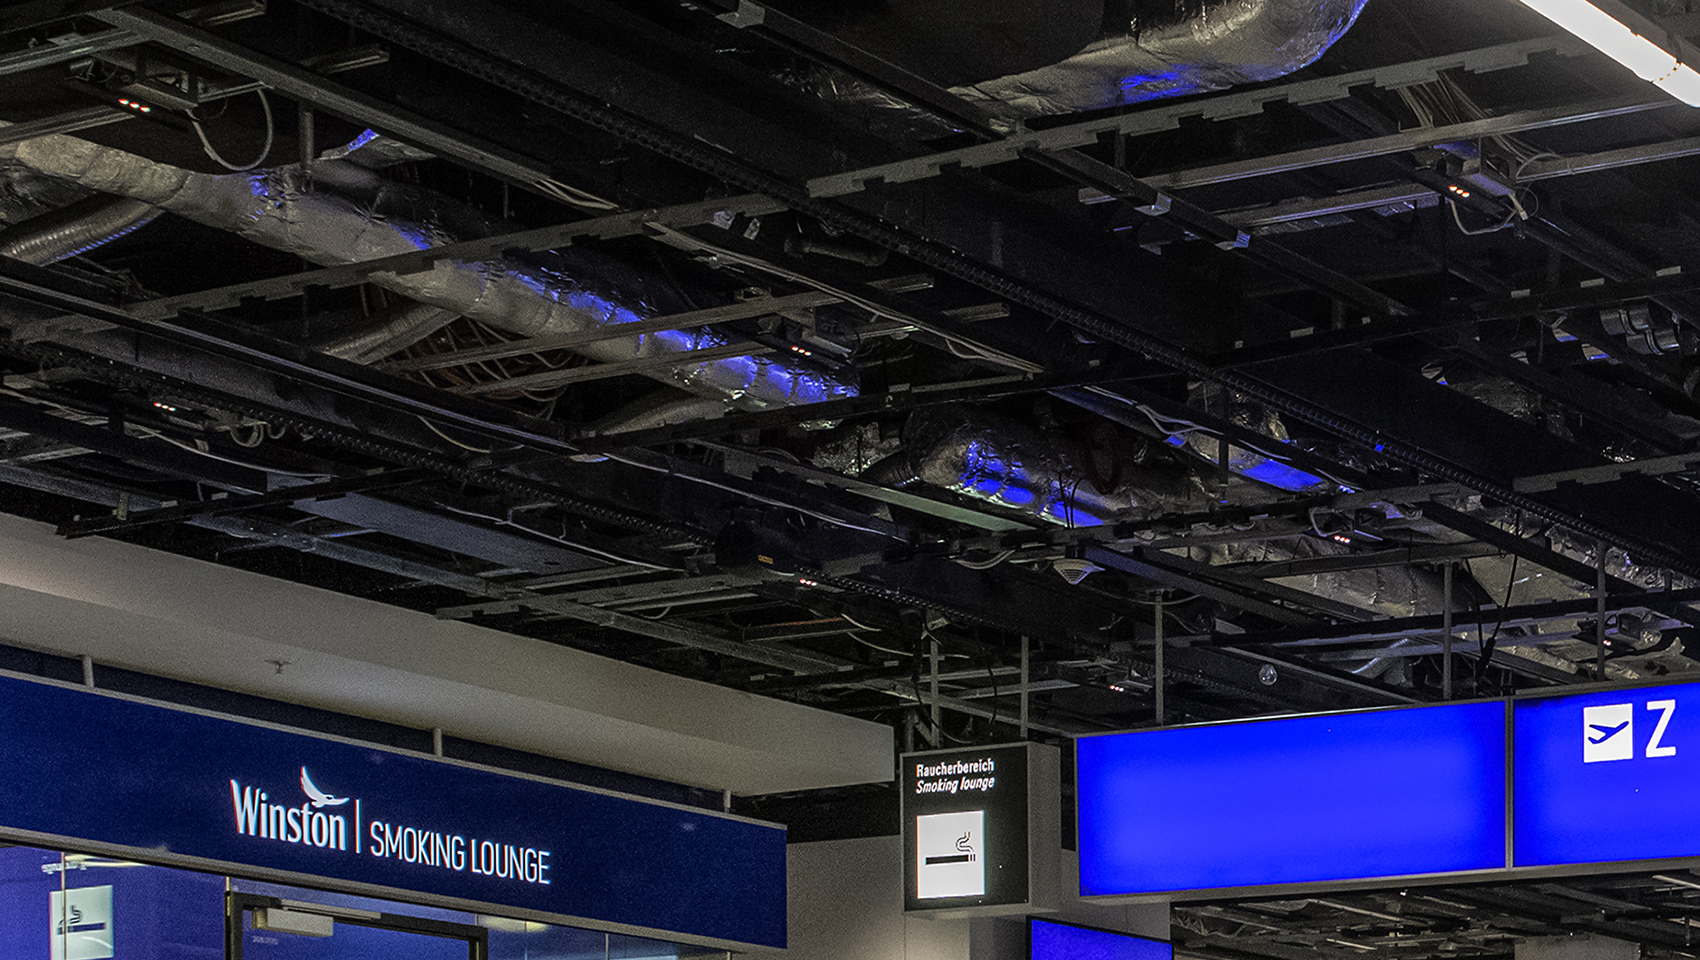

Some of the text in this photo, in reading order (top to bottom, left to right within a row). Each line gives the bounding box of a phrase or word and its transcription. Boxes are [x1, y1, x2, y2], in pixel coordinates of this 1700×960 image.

[1645, 699, 1676, 758] Z
[916, 758, 995, 777] Raucherbereich
[916, 776, 995, 794] Smoking lounge
[230, 779, 551, 884] Winston SMOKING LOUNGE
